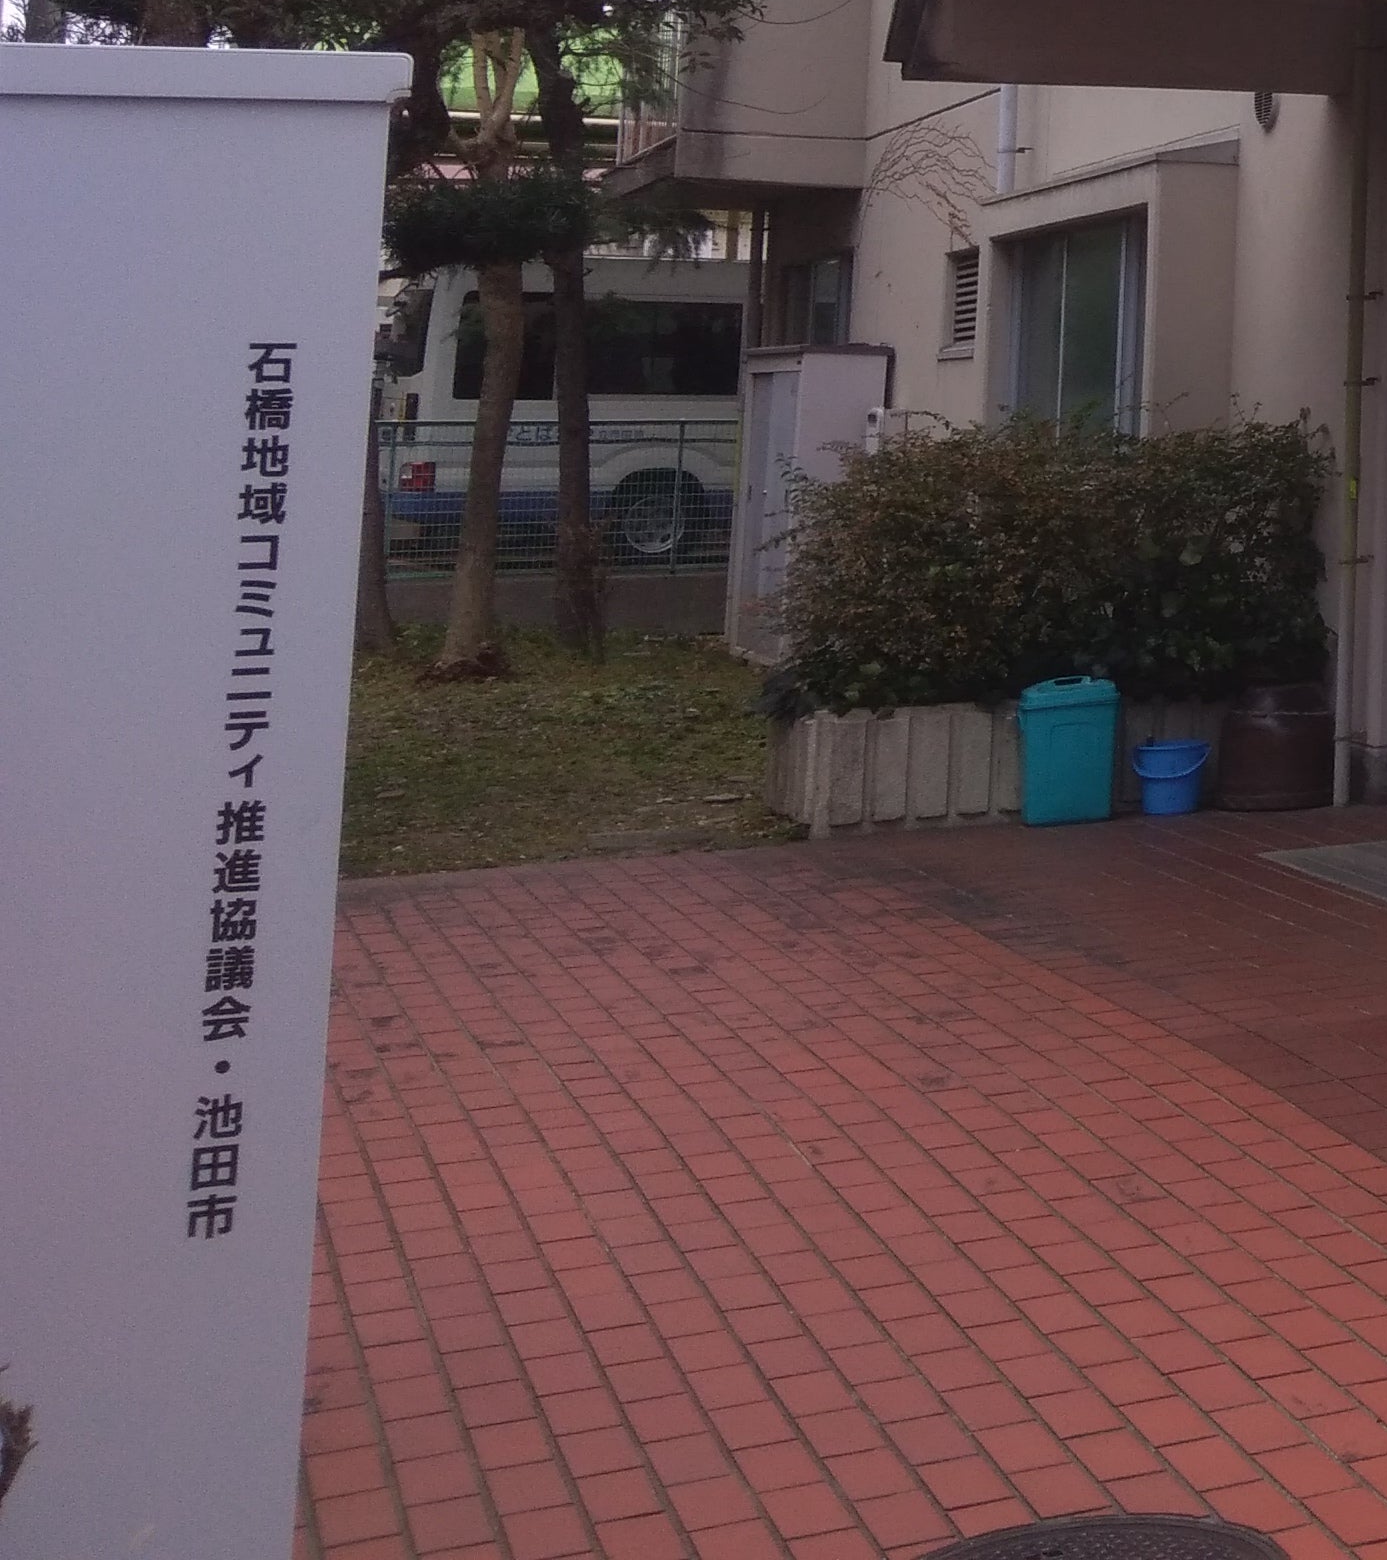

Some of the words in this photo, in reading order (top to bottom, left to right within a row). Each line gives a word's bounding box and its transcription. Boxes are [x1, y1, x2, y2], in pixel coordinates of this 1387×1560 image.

[187, 342, 298, 1239] 石橋地域コミュニティ推進協議会・池田市
